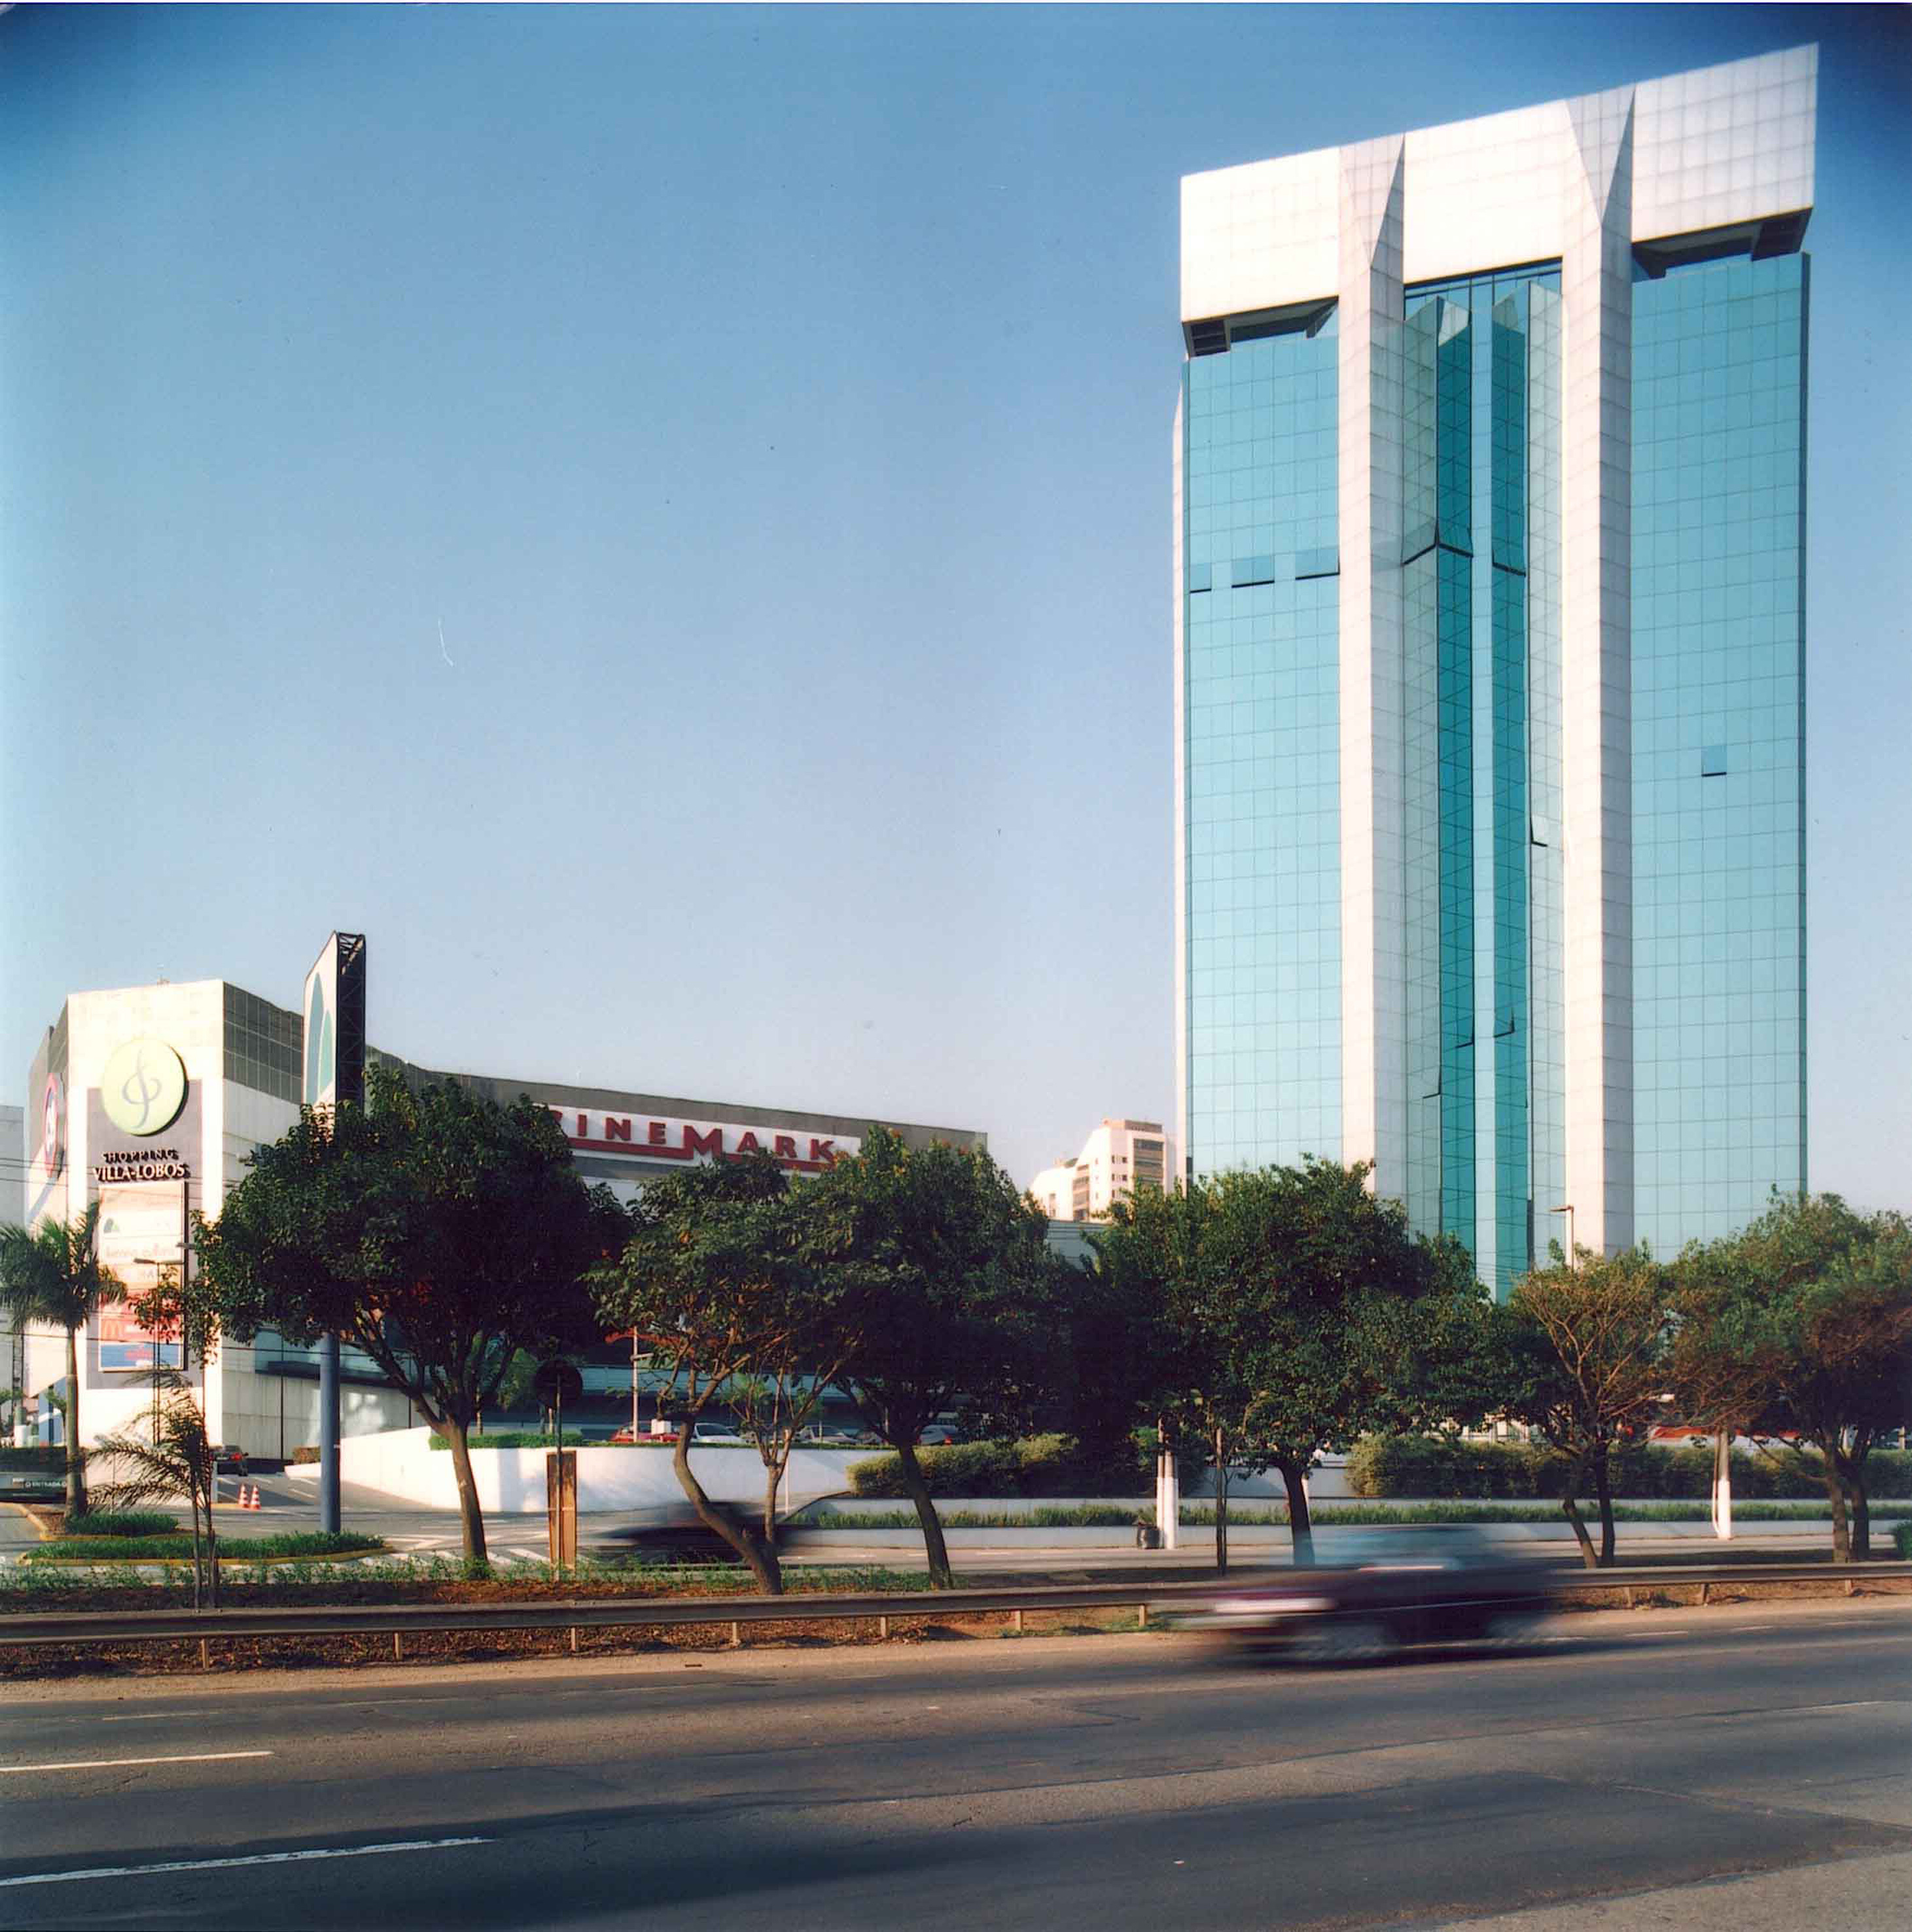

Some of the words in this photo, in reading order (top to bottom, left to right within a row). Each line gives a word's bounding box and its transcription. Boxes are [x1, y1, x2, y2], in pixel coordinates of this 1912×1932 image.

[549, 1110, 836, 1163] INEMARK
[101, 1147, 179, 1163] SHOPPING
[93, 1163, 186, 1181] VILLA-LOBOS
